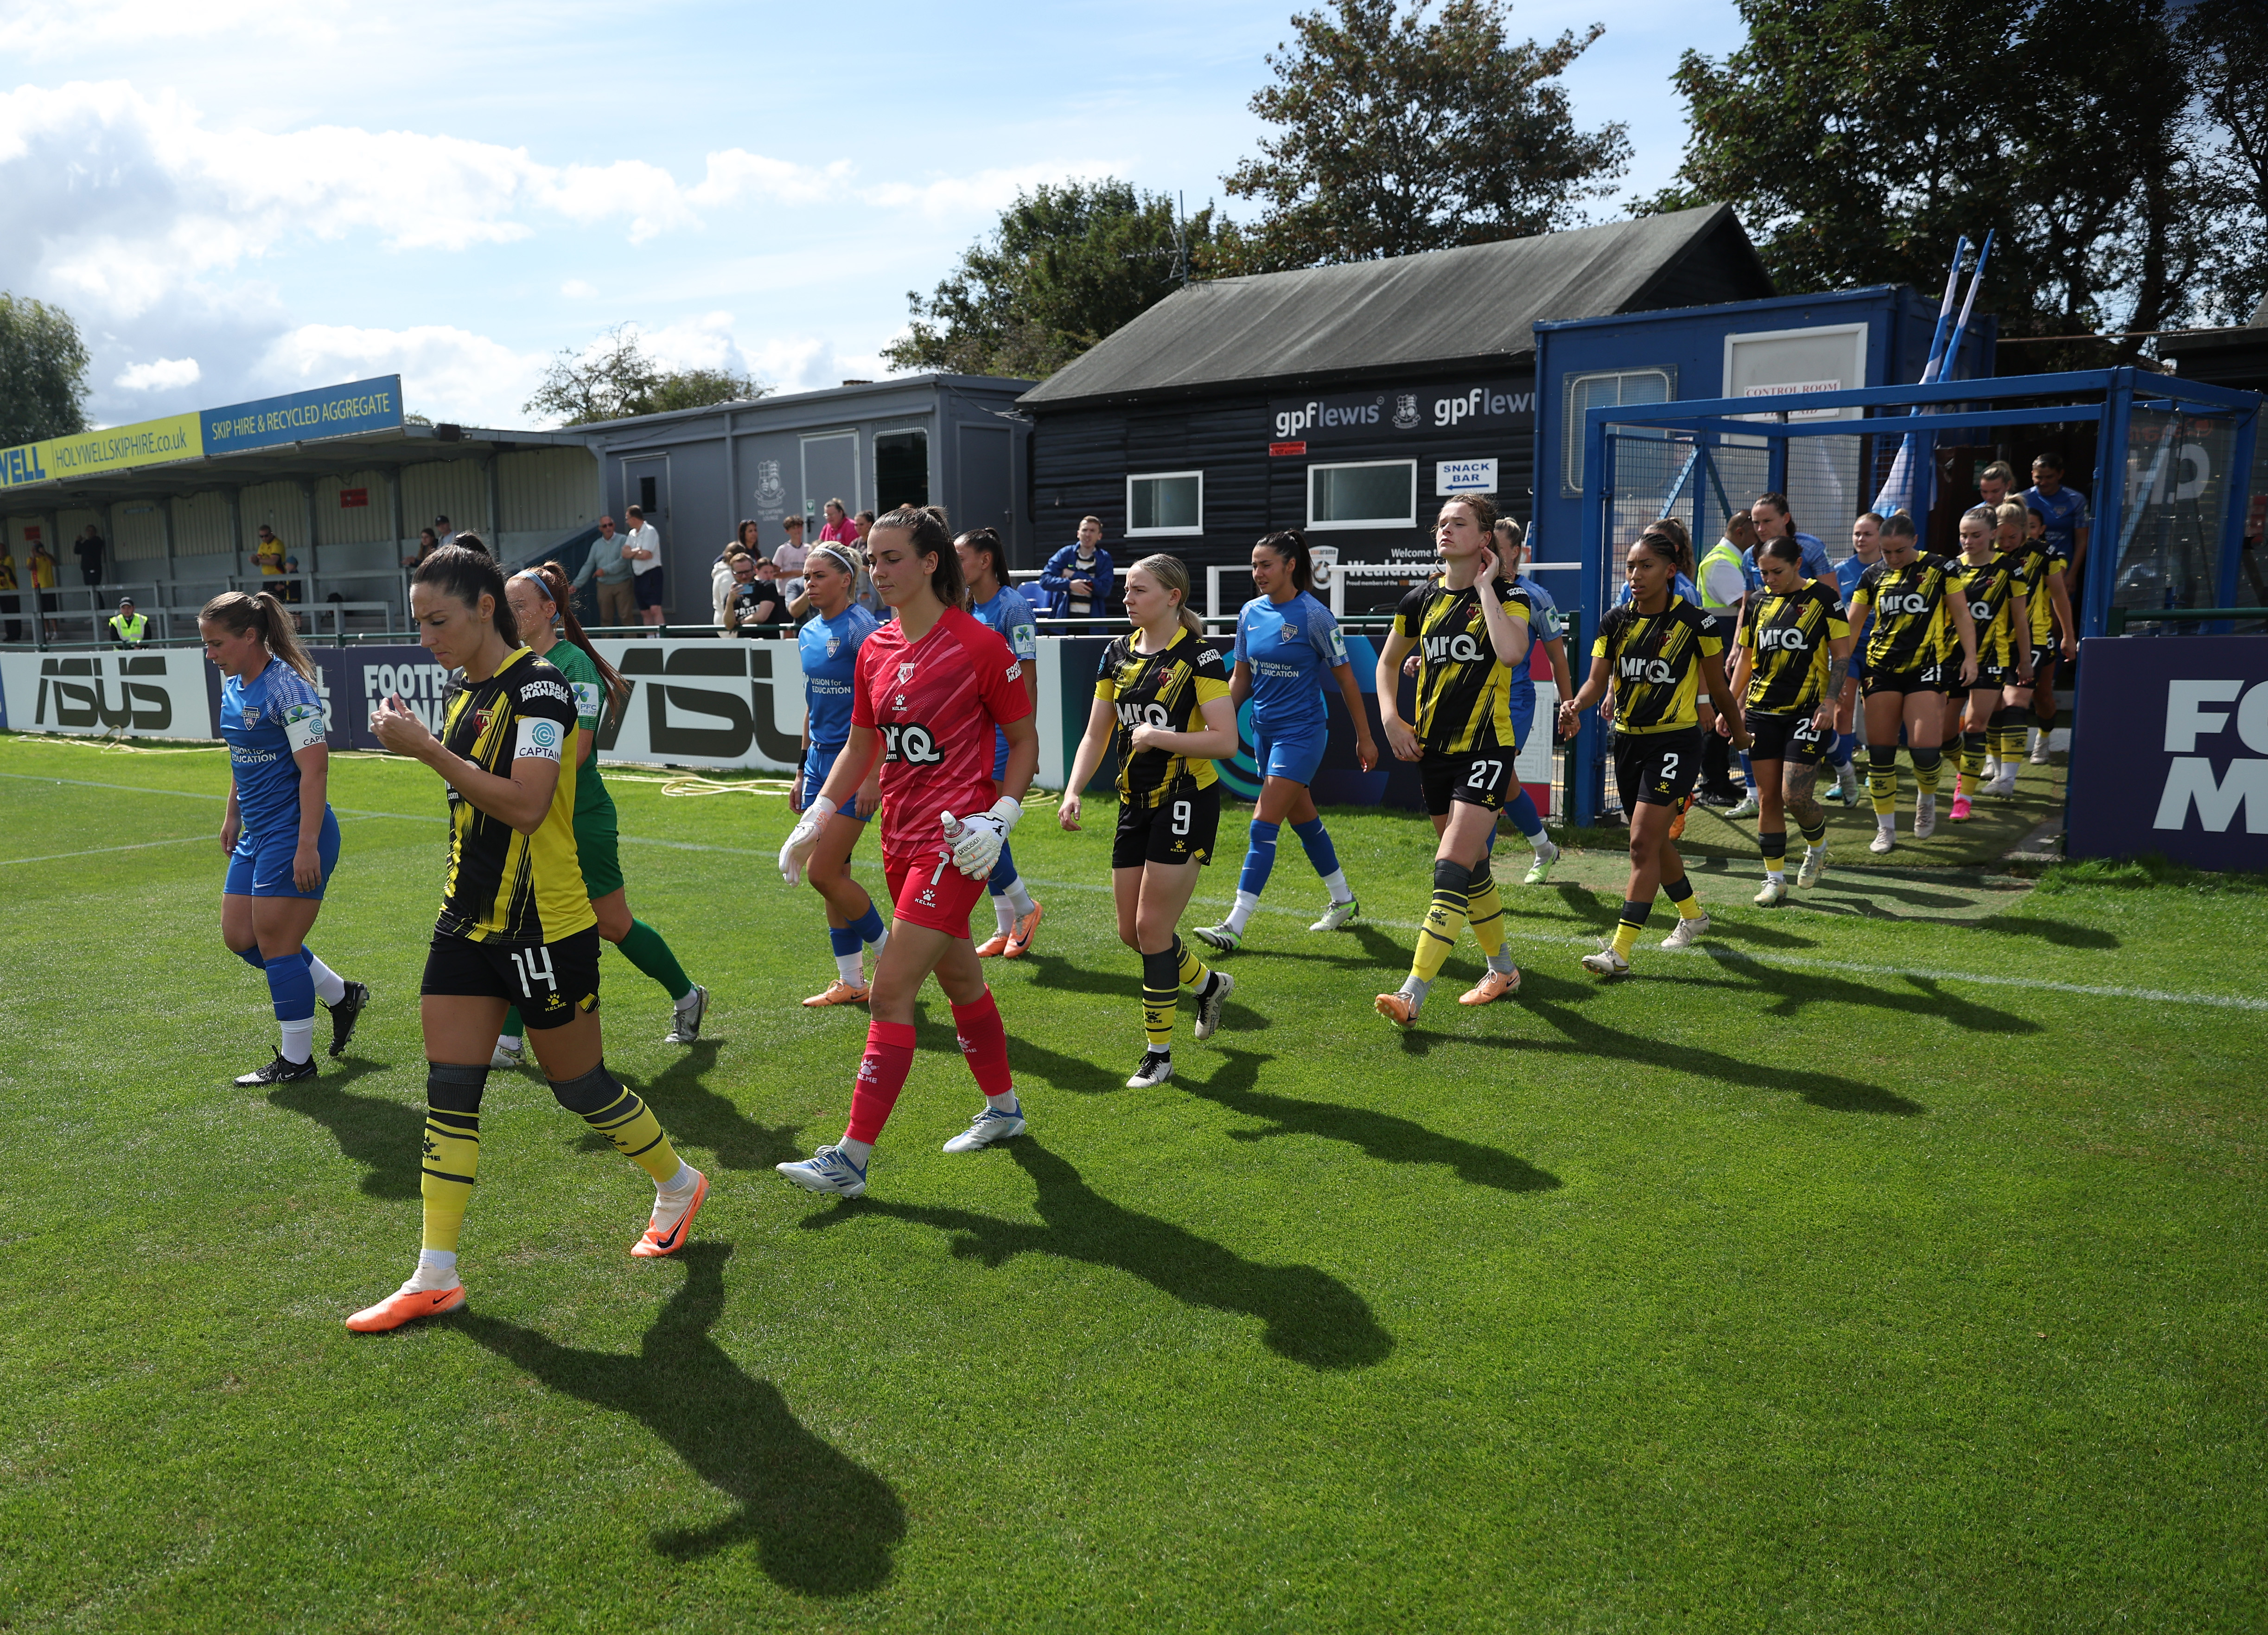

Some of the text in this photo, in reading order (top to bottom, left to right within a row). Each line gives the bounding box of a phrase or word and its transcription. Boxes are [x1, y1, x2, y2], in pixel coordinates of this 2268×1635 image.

[1746, 383, 1837, 397] CONTROL ROOM
[212, 392, 390, 440] SKIP HIRE & RECYCLED AGGREGATE
[1434, 388, 1535, 426] gpflewi
[1275, 401, 1380, 438] gpflewis
[55, 426, 187, 468] HOLYWELLSKIPHIRE.co.uk
[1444, 463, 1490, 473] SNACK
[1391, 548, 1432, 558] Welcome
[1880, 593, 1930, 614] MrQ
[1423, 634, 1484, 662] MrQ
[1758, 628, 1808, 650] MrQ
[1260, 662, 1280, 670] VISION
[1261, 669, 1299, 677] EDUCATION
[1621, 657, 1676, 683] MrQ
[520, 680, 569, 698] FOOTBALL
[810, 677, 830, 686] VISION
[812, 685, 851, 695] EDUCATION
[35, 656, 172, 730] ASUS
[522, 688, 568, 706] MANAGER
[1115, 703, 1176, 732] MrQ
[231, 745, 251, 754] VISION
[232, 753, 276, 763] EDUCATION
[519, 747, 560, 761] CAPTAIN
[1467, 760, 1503, 790] 27
[1661, 753, 1679, 779] 2
[1172, 801, 1191, 835] 9
[958, 837, 981, 856] precision
[915, 898, 936, 908] KELME
[511, 946, 557, 998] 14
[545, 1002, 567, 1012] KELME
